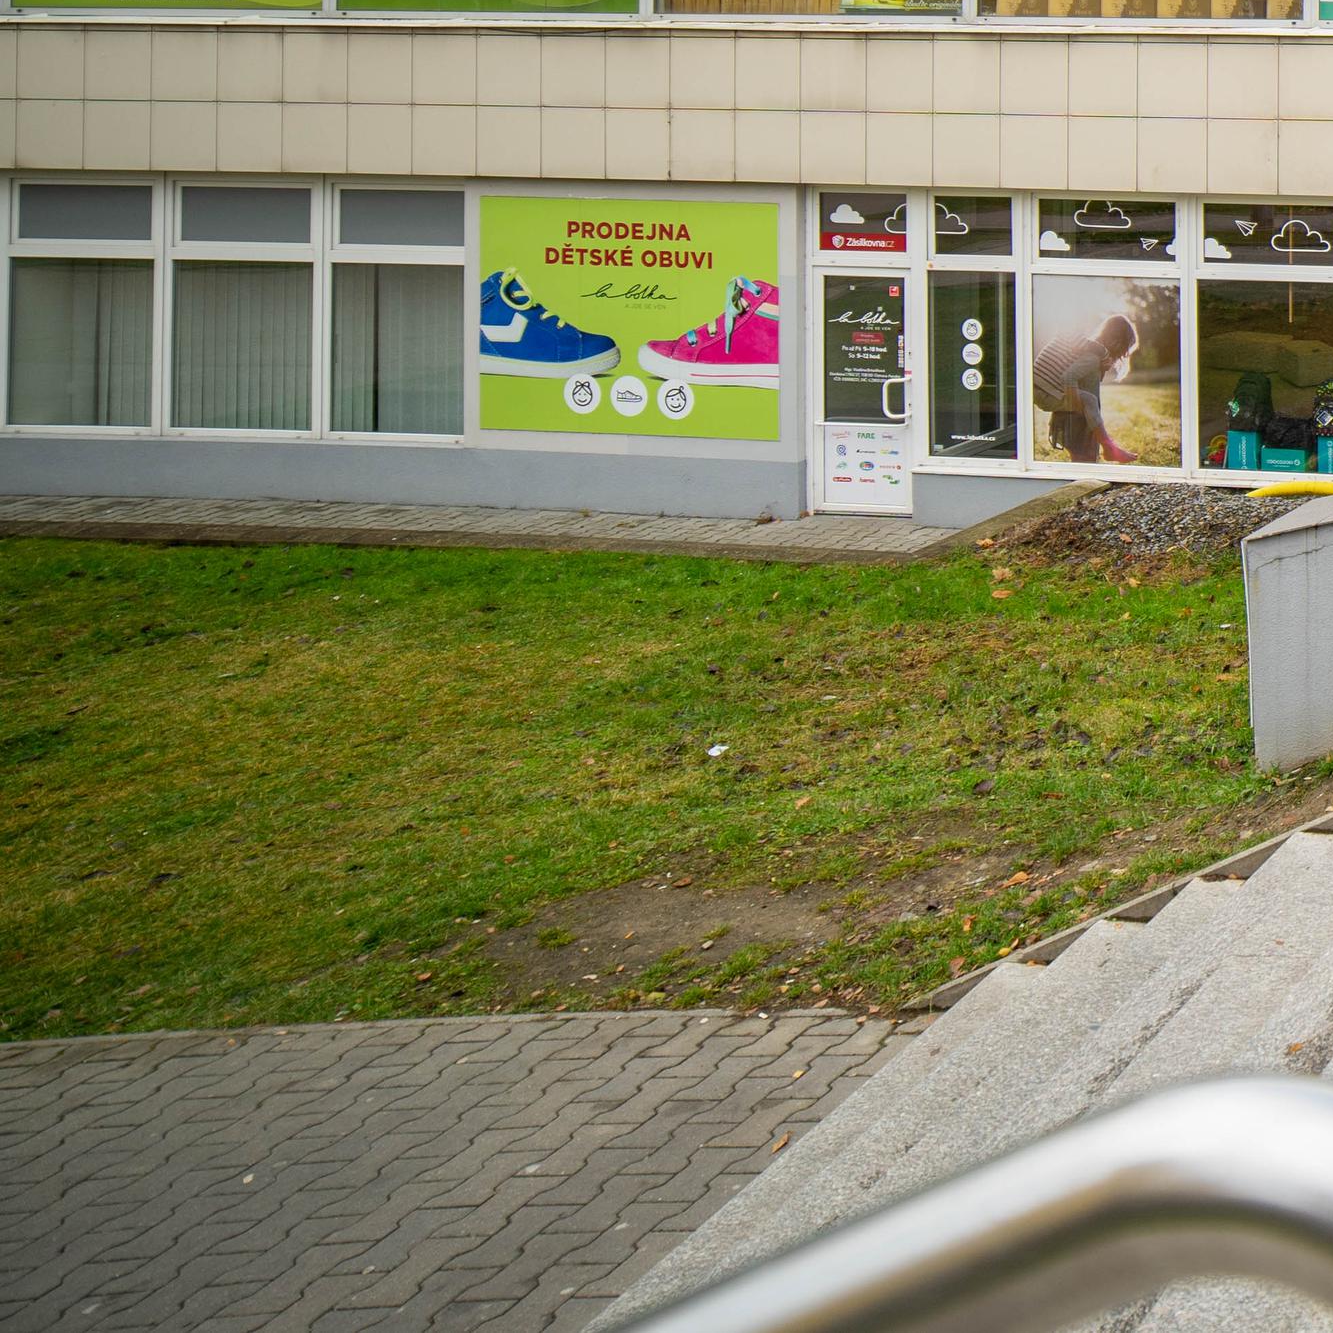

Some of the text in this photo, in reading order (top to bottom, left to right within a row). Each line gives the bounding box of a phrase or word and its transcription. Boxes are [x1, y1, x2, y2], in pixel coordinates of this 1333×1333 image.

[567, 221, 691, 242] PRODEJNA
[545, 243, 713, 269] DĚTSKÉ OBUVI
[618, 283, 677, 301] botka
